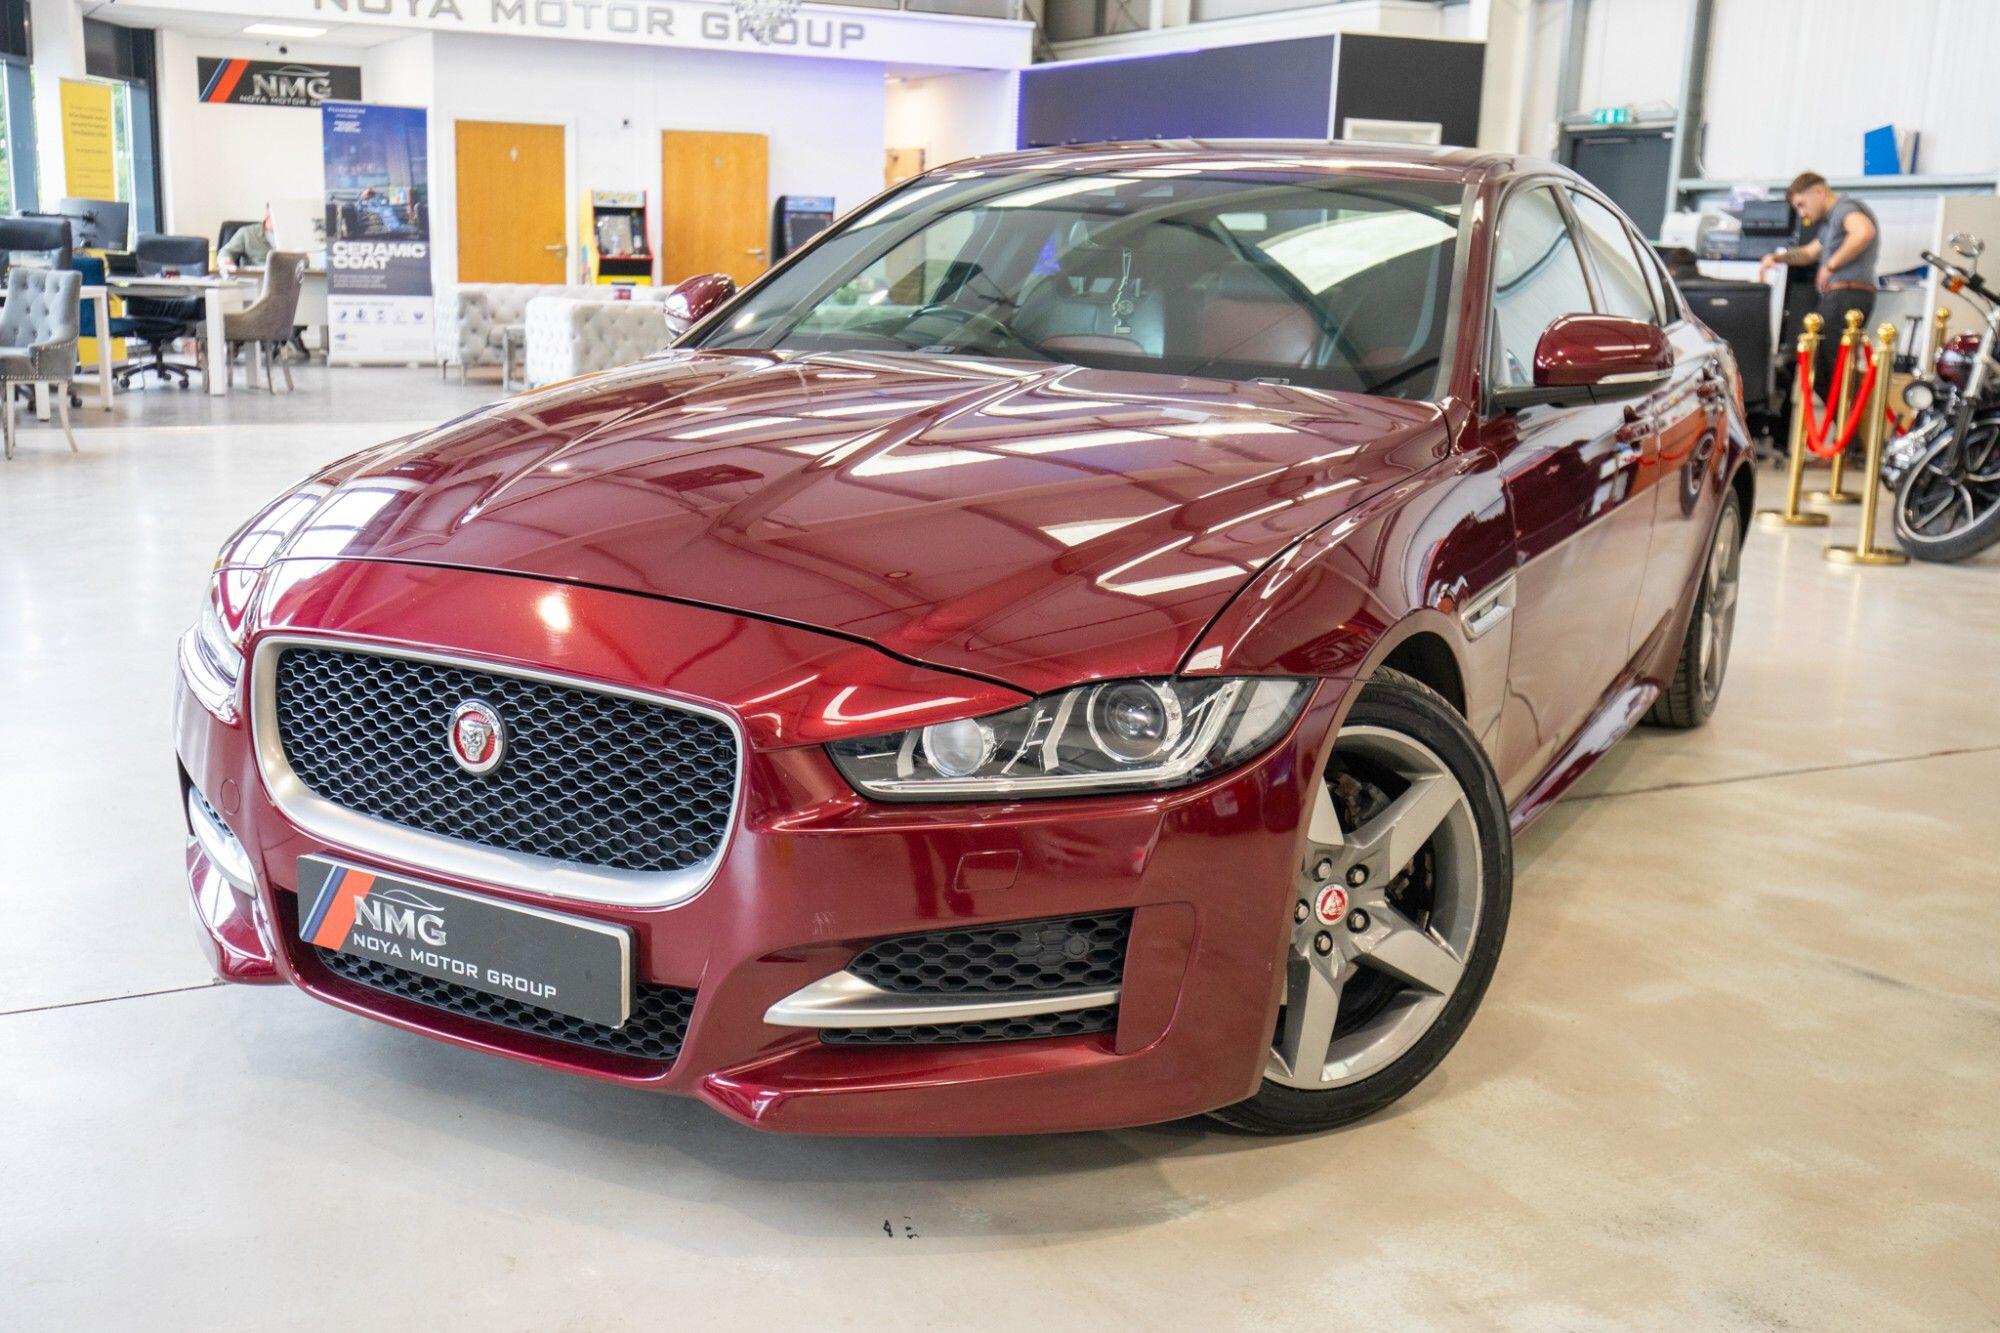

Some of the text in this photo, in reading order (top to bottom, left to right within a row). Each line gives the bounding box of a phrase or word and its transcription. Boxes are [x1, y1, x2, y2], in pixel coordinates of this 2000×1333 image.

[491, 0, 675, 36] MOTOR
[252, 73, 332, 99] NMG
[332, 241, 426, 258] CERAMIC
[332, 254, 391, 270] COAT
[352, 895, 447, 947] NMG
[352, 932, 557, 999] NOYA MOTOR GROUP
